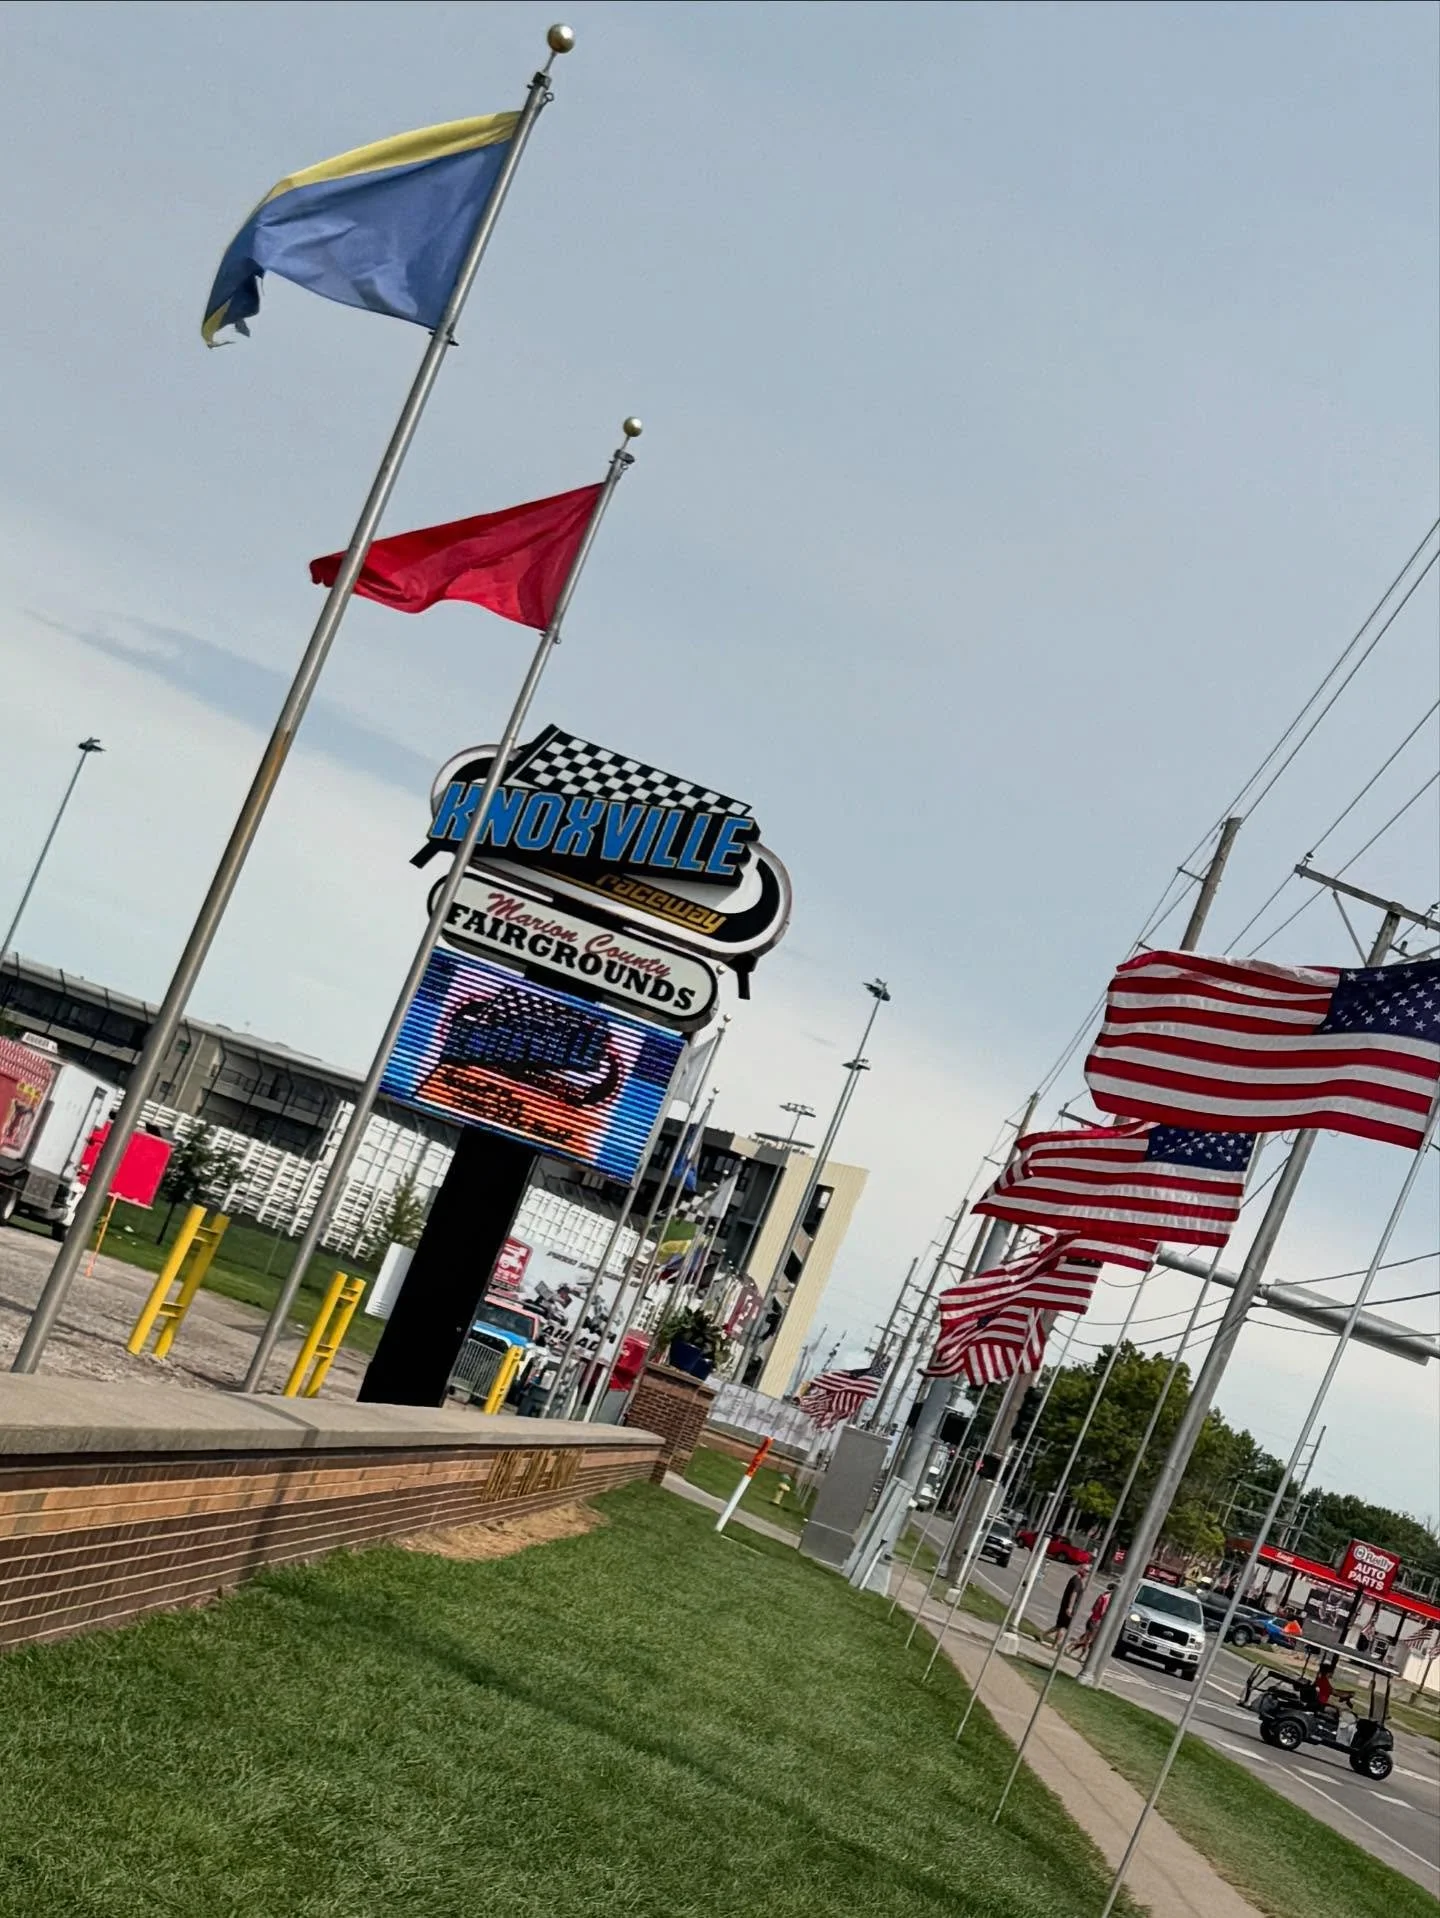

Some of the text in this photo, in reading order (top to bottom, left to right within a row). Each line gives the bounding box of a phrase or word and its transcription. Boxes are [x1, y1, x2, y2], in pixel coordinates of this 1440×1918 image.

[430, 781, 754, 876] KNOXVILLE
[486, 891, 671, 978] Marion County
[595, 873, 727, 934] raceway
[445, 902, 696, 1010] FAIRGROUNDS
[1348, 1570, 1385, 1591] PARTS
[1354, 1562, 1386, 1580] AUTO
